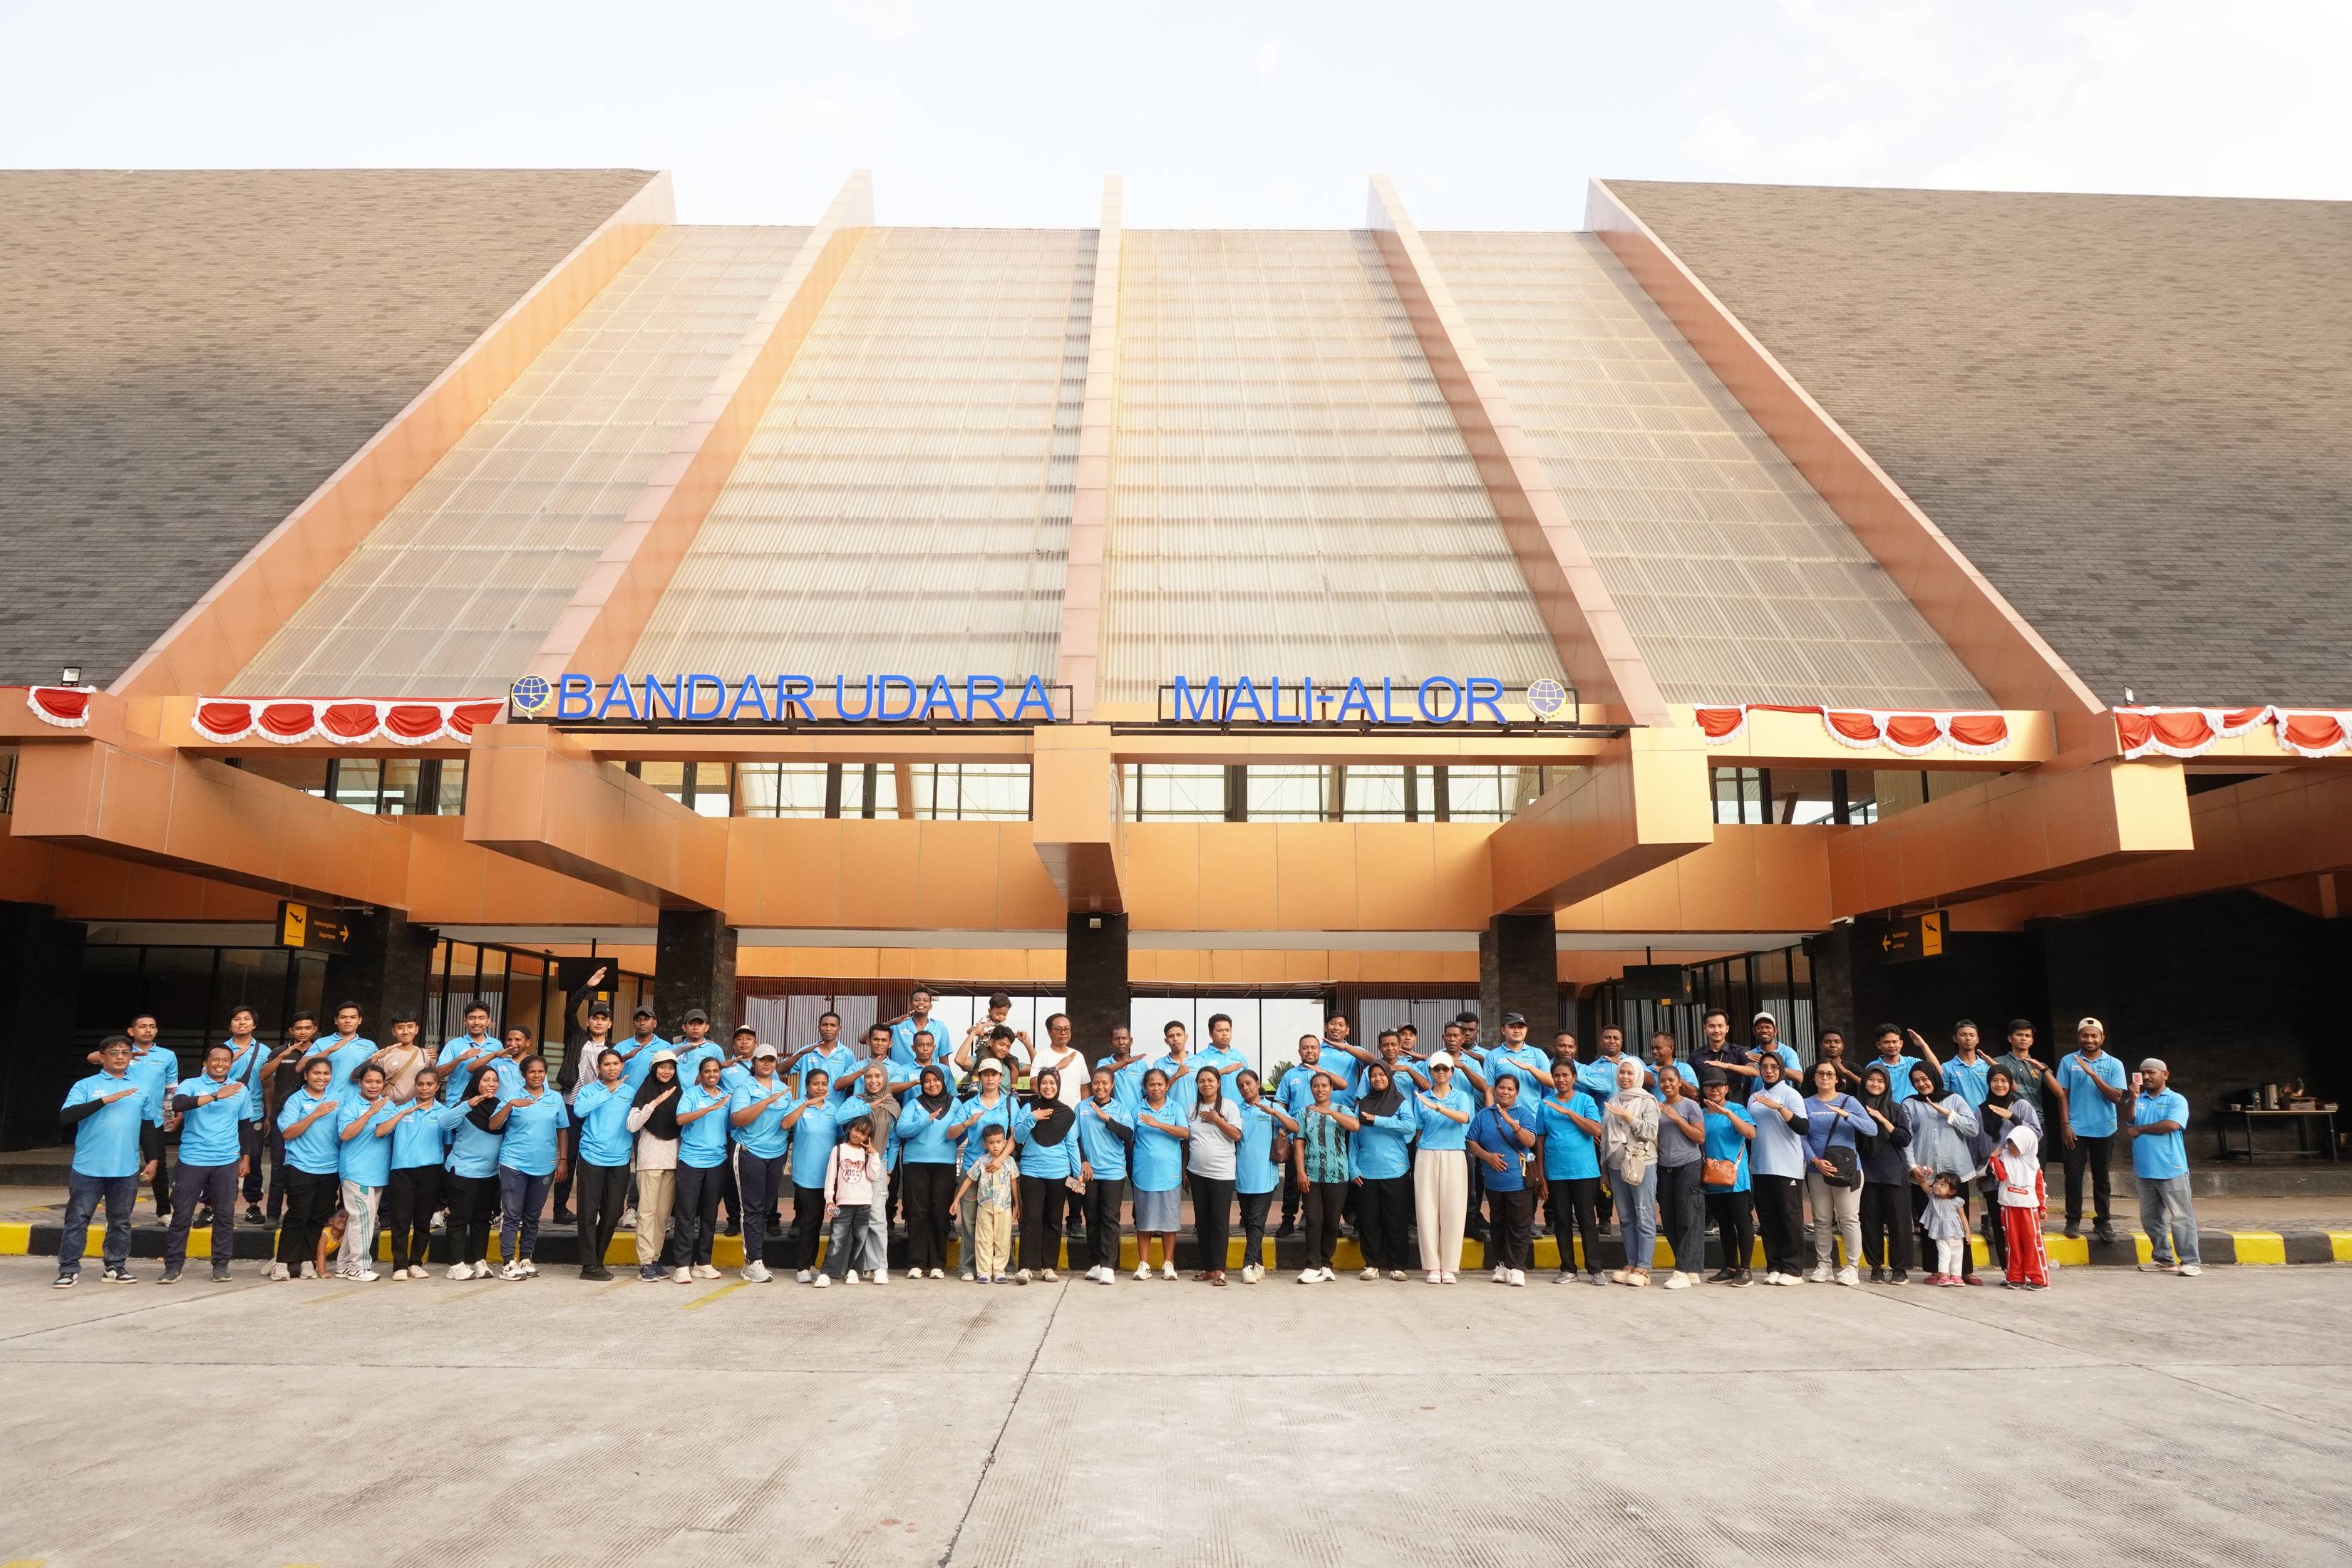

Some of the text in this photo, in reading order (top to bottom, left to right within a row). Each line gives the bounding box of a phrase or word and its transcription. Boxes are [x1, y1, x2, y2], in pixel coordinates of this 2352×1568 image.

[557, 674, 1057, 721] BANDAR UDARA
[1174, 676, 1507, 723] MALI-ALOR
